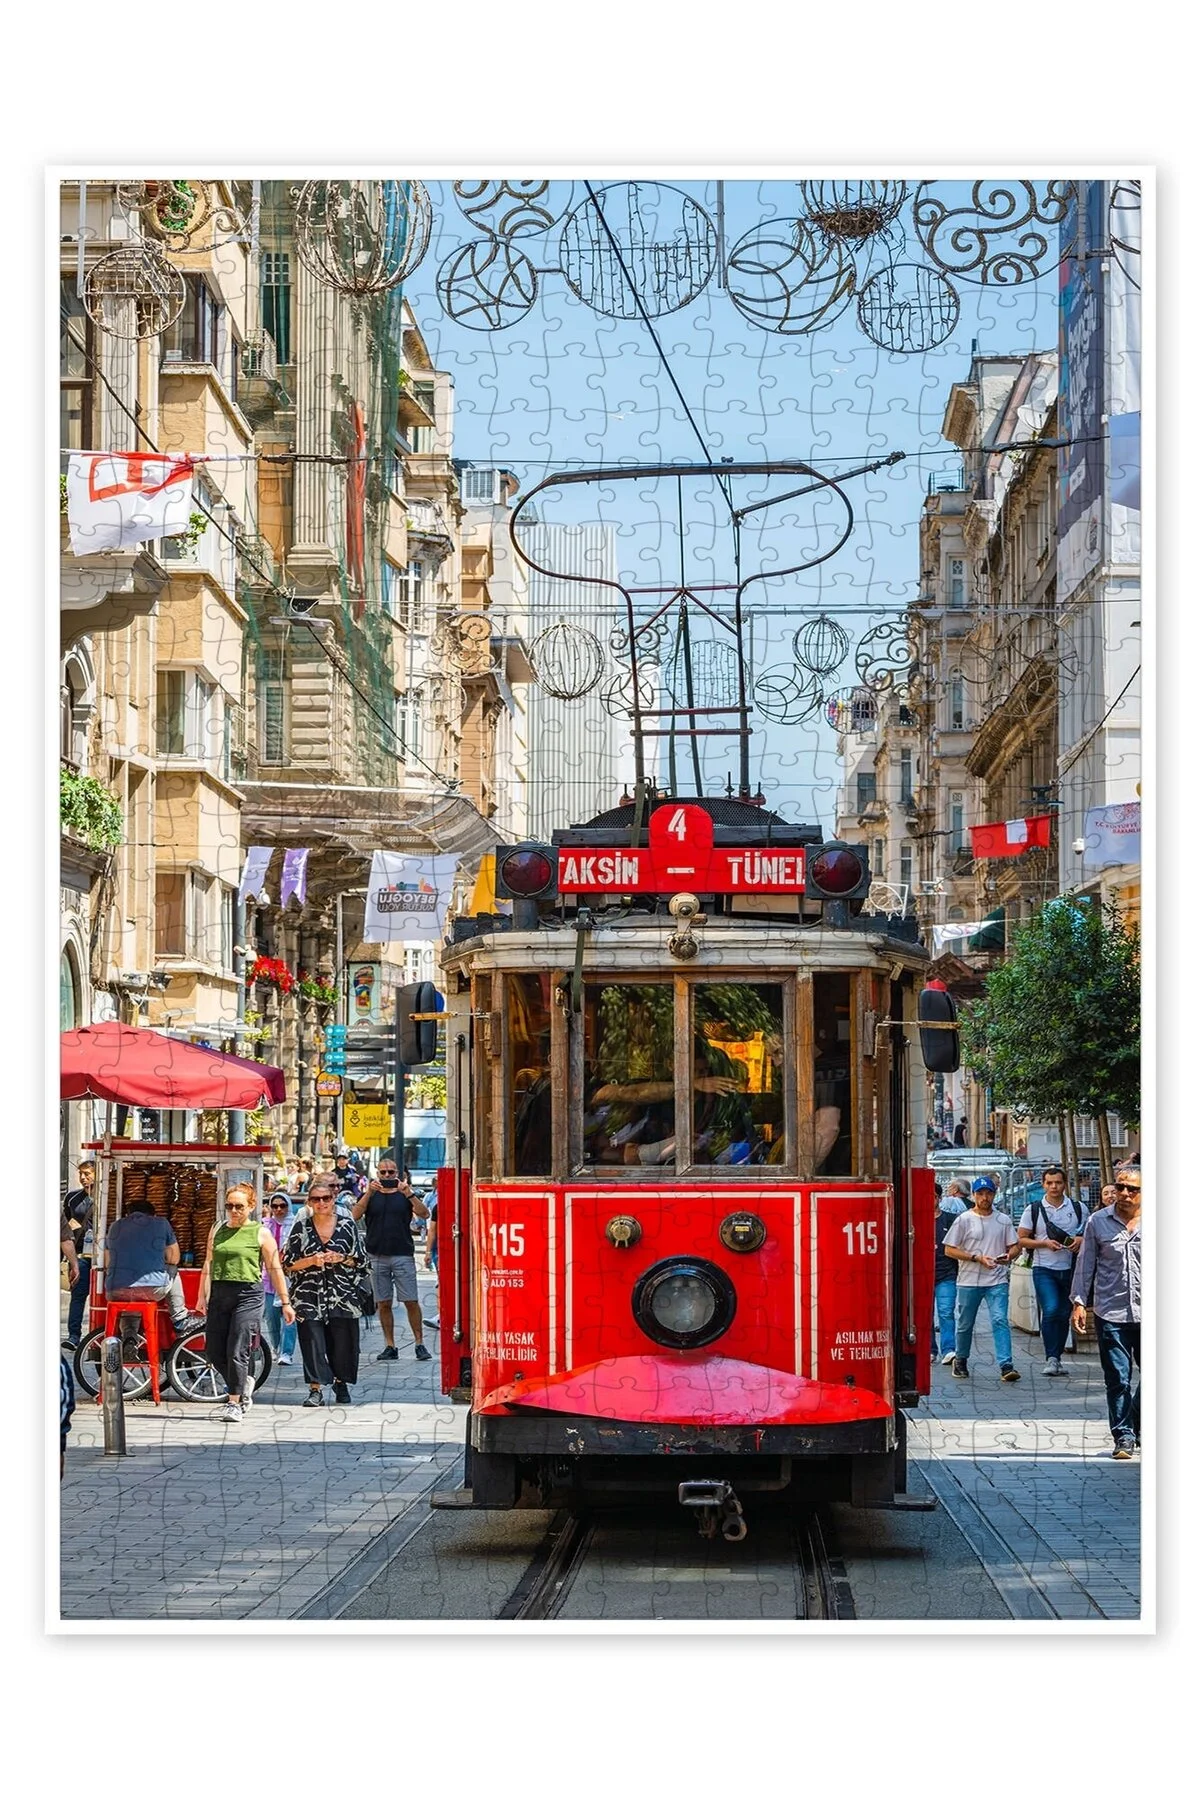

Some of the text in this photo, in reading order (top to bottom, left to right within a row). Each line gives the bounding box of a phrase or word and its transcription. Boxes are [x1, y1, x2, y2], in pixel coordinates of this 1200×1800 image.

[668, 809, 687, 841] 4
[489, 1223, 525, 1257] 115
[842, 1221, 878, 1256] 115
[507, 1279, 524, 1288] 153
[504, 1331, 535, 1346] YASAK
[830, 1347, 845, 1361] VE
